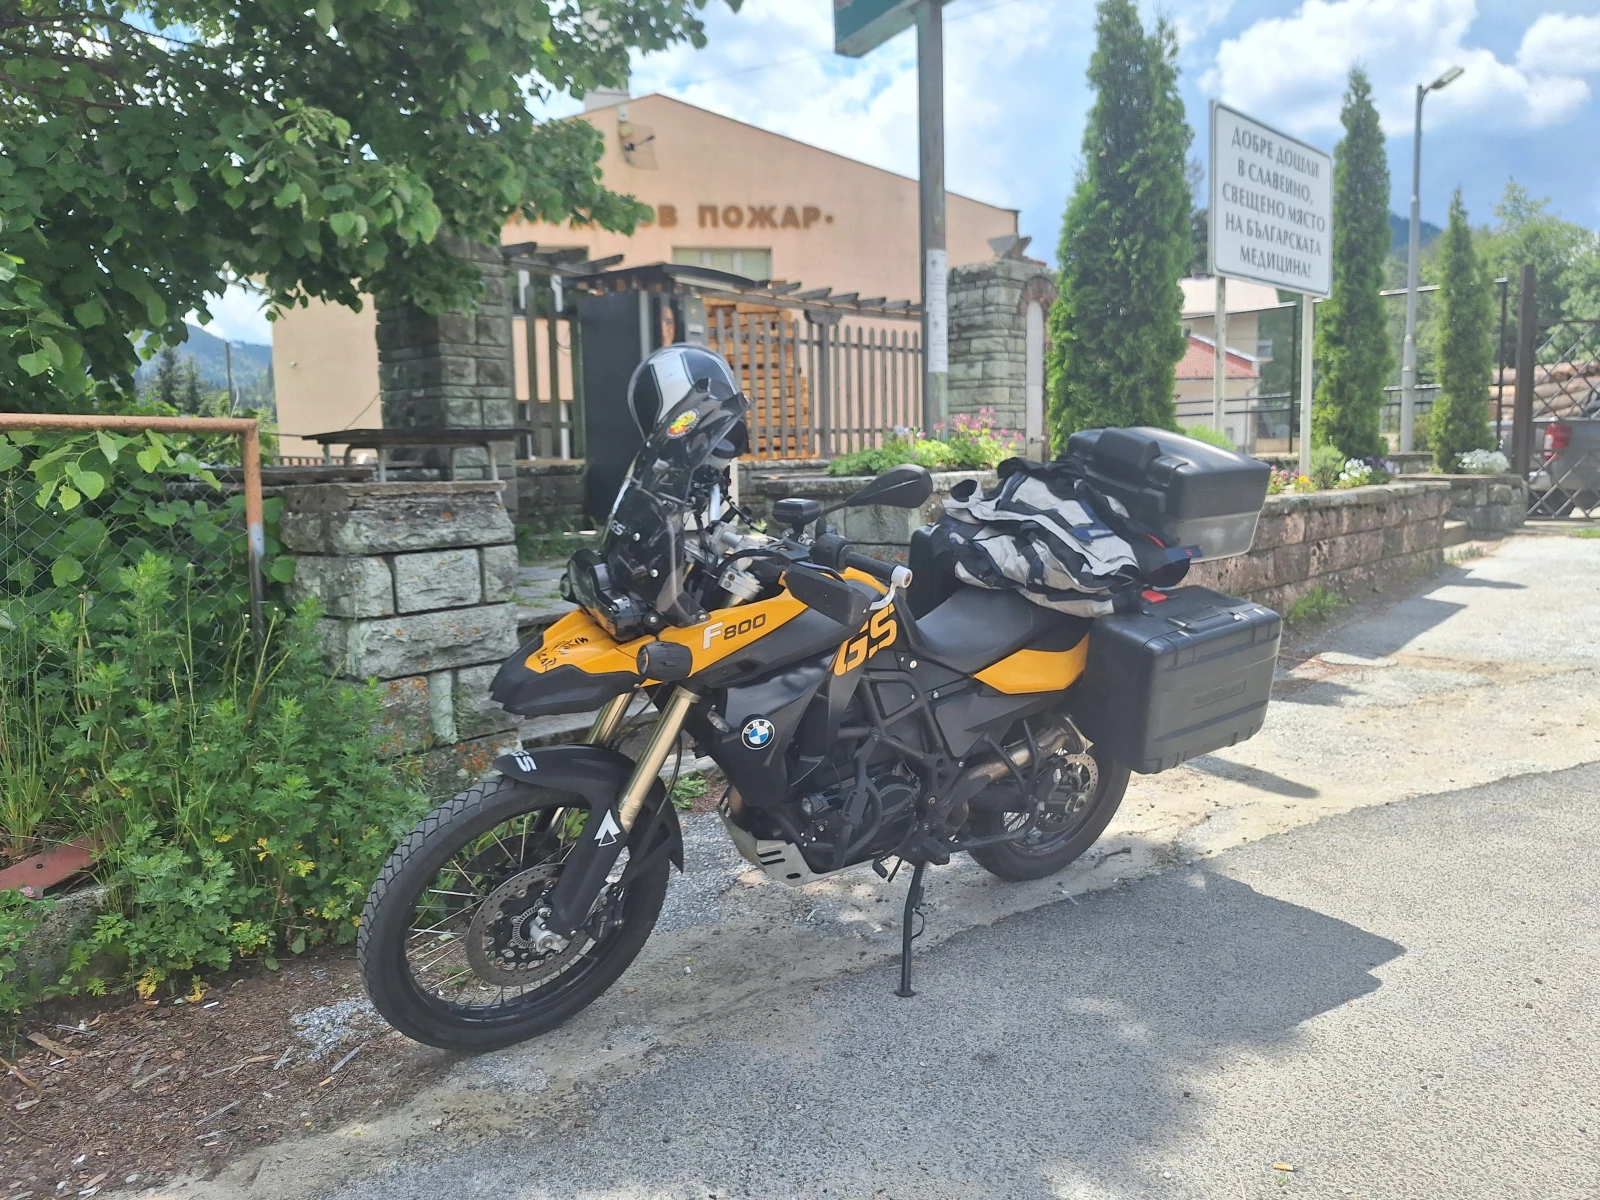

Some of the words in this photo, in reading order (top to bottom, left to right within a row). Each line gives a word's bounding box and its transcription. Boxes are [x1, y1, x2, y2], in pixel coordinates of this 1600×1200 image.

[1231, 126, 1273, 159] ДОБРЕ
[1276, 147, 1320, 178] ДОШЛИ
[1238, 158, 1246, 177] В
[1222, 183, 1285, 220] СВЕЩЕНО
[1288, 209, 1325, 233] МЯСТО
[1225, 212, 1244, 235] НА
[1246, 219, 1322, 257] БЪЛГАРСКАТА
[1240, 245, 1312, 278] МЕДИЦИНА!
[833, 602, 897, 676] GS
